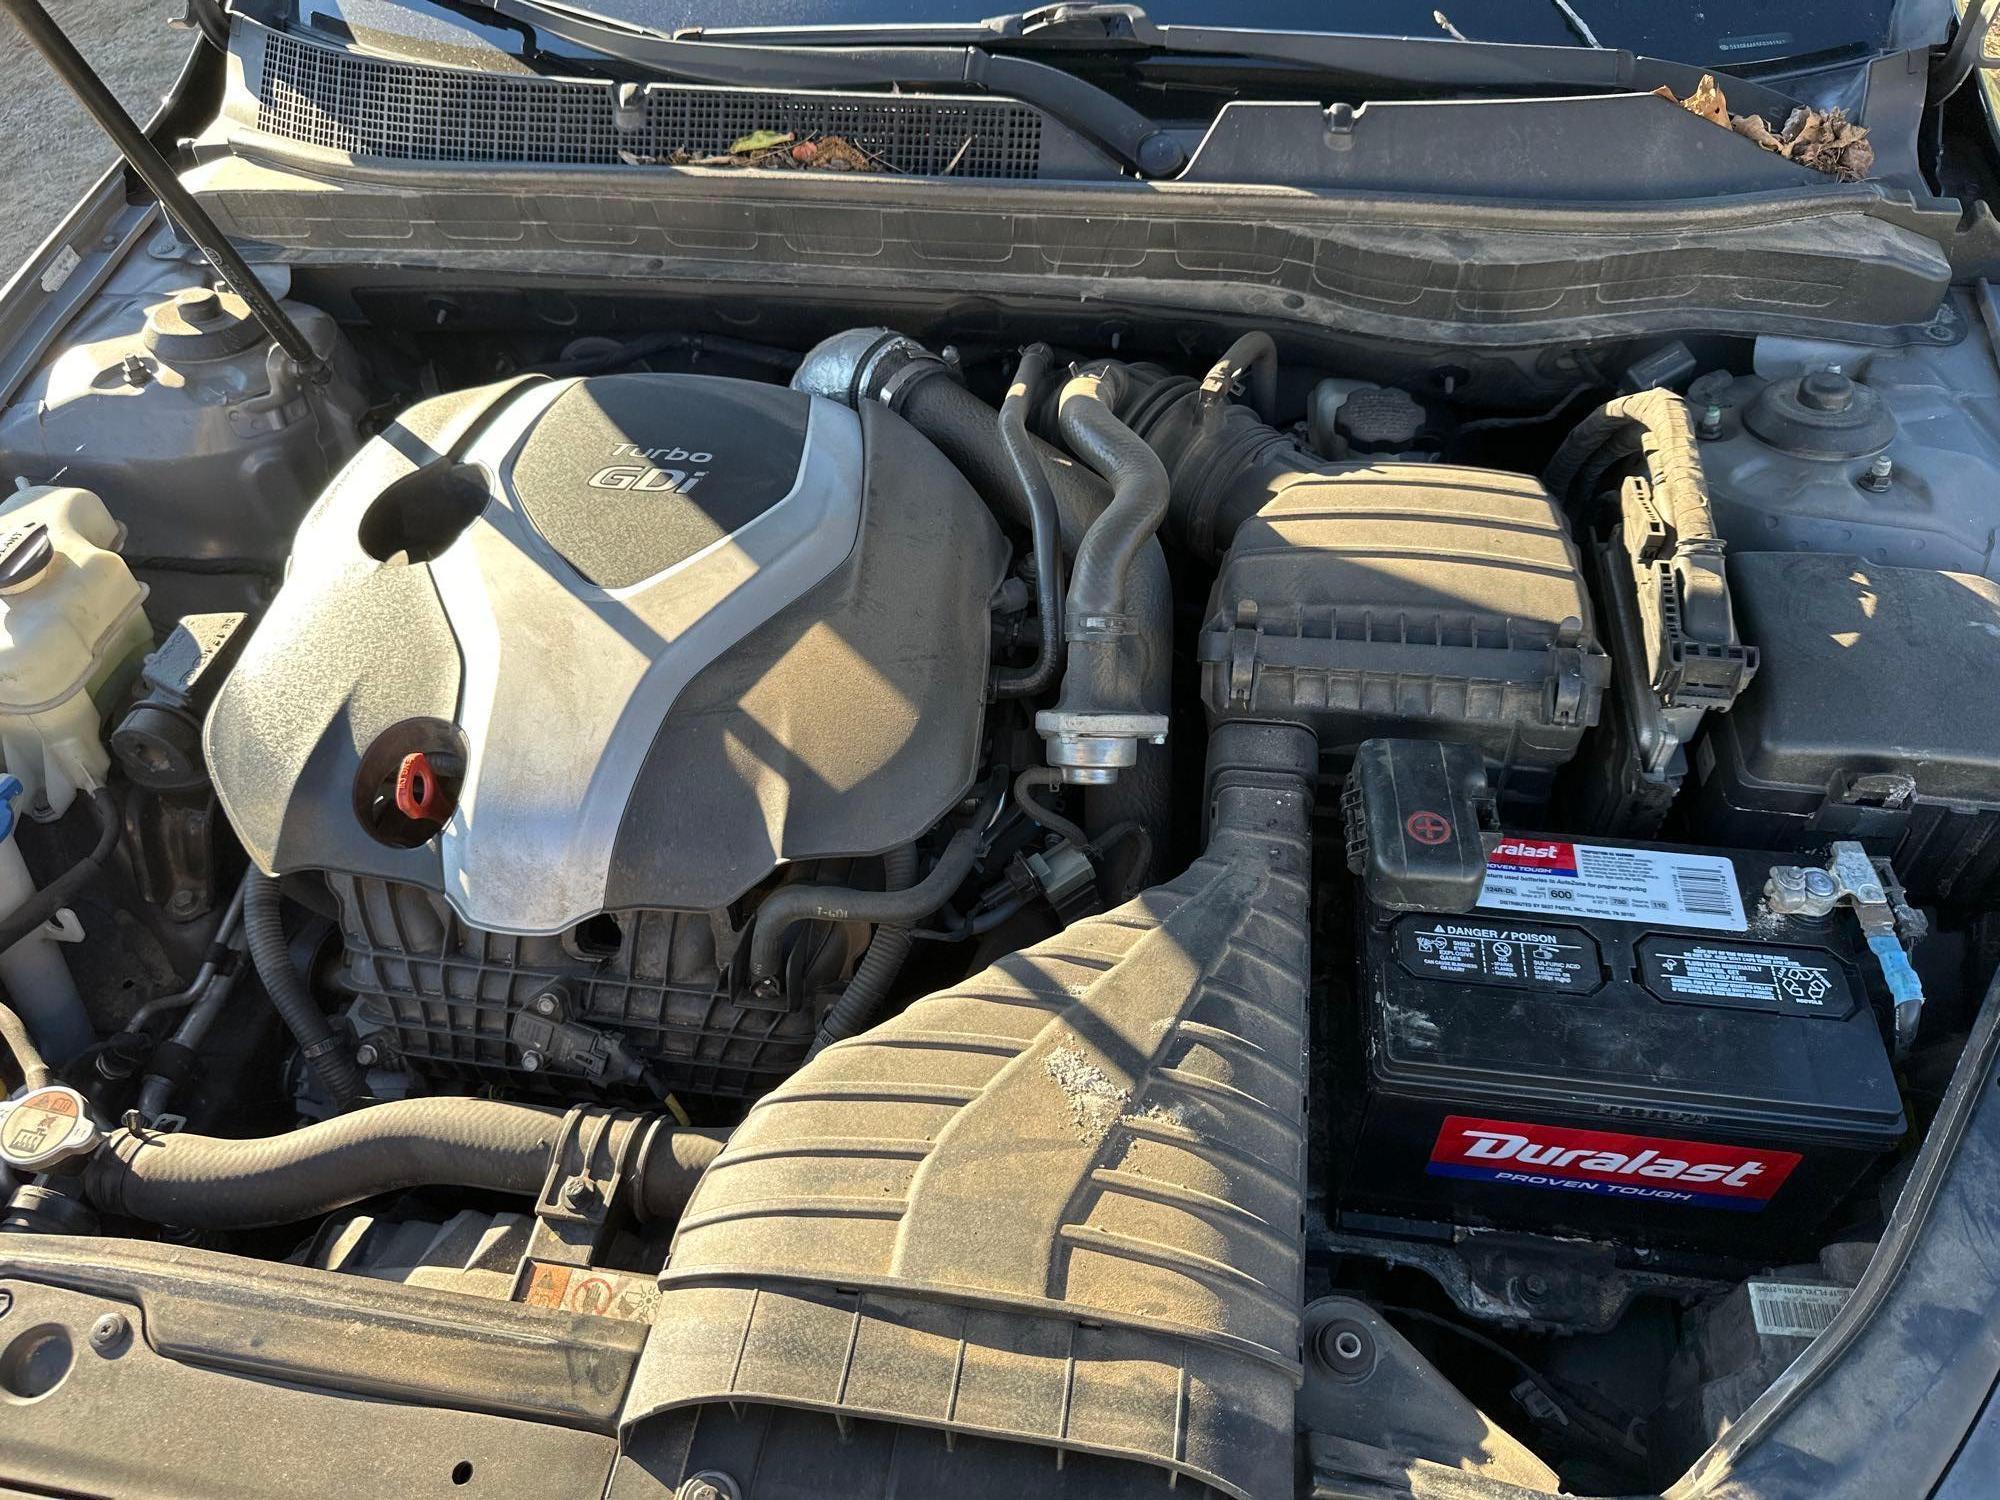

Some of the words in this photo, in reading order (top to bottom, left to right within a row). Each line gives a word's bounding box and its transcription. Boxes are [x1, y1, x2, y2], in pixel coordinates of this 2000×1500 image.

[612, 442, 713, 463] Turbo
[588, 464, 708, 494] GDi
[1491, 843, 1558, 859] ralast
[1520, 866, 1552, 874] TOUGH
[1521, 876, 1547, 884] batteries
[1557, 879, 1586, 887] AutoZone
[1551, 889, 1572, 900] 600
[1447, 926, 1498, 939] DANGER
[1511, 932, 1557, 944] POISON
[1439, 950, 1475, 958] EXPLOSIVE
[1534, 960, 1565, 968] SULFURIC
[1721, 963, 1761, 972] IMMEDIATELY
[1462, 1130, 1765, 1187] Duralast
[1495, 1172, 1599, 1190] PROVEN
[1607, 1185, 1692, 1200] TOUGH
